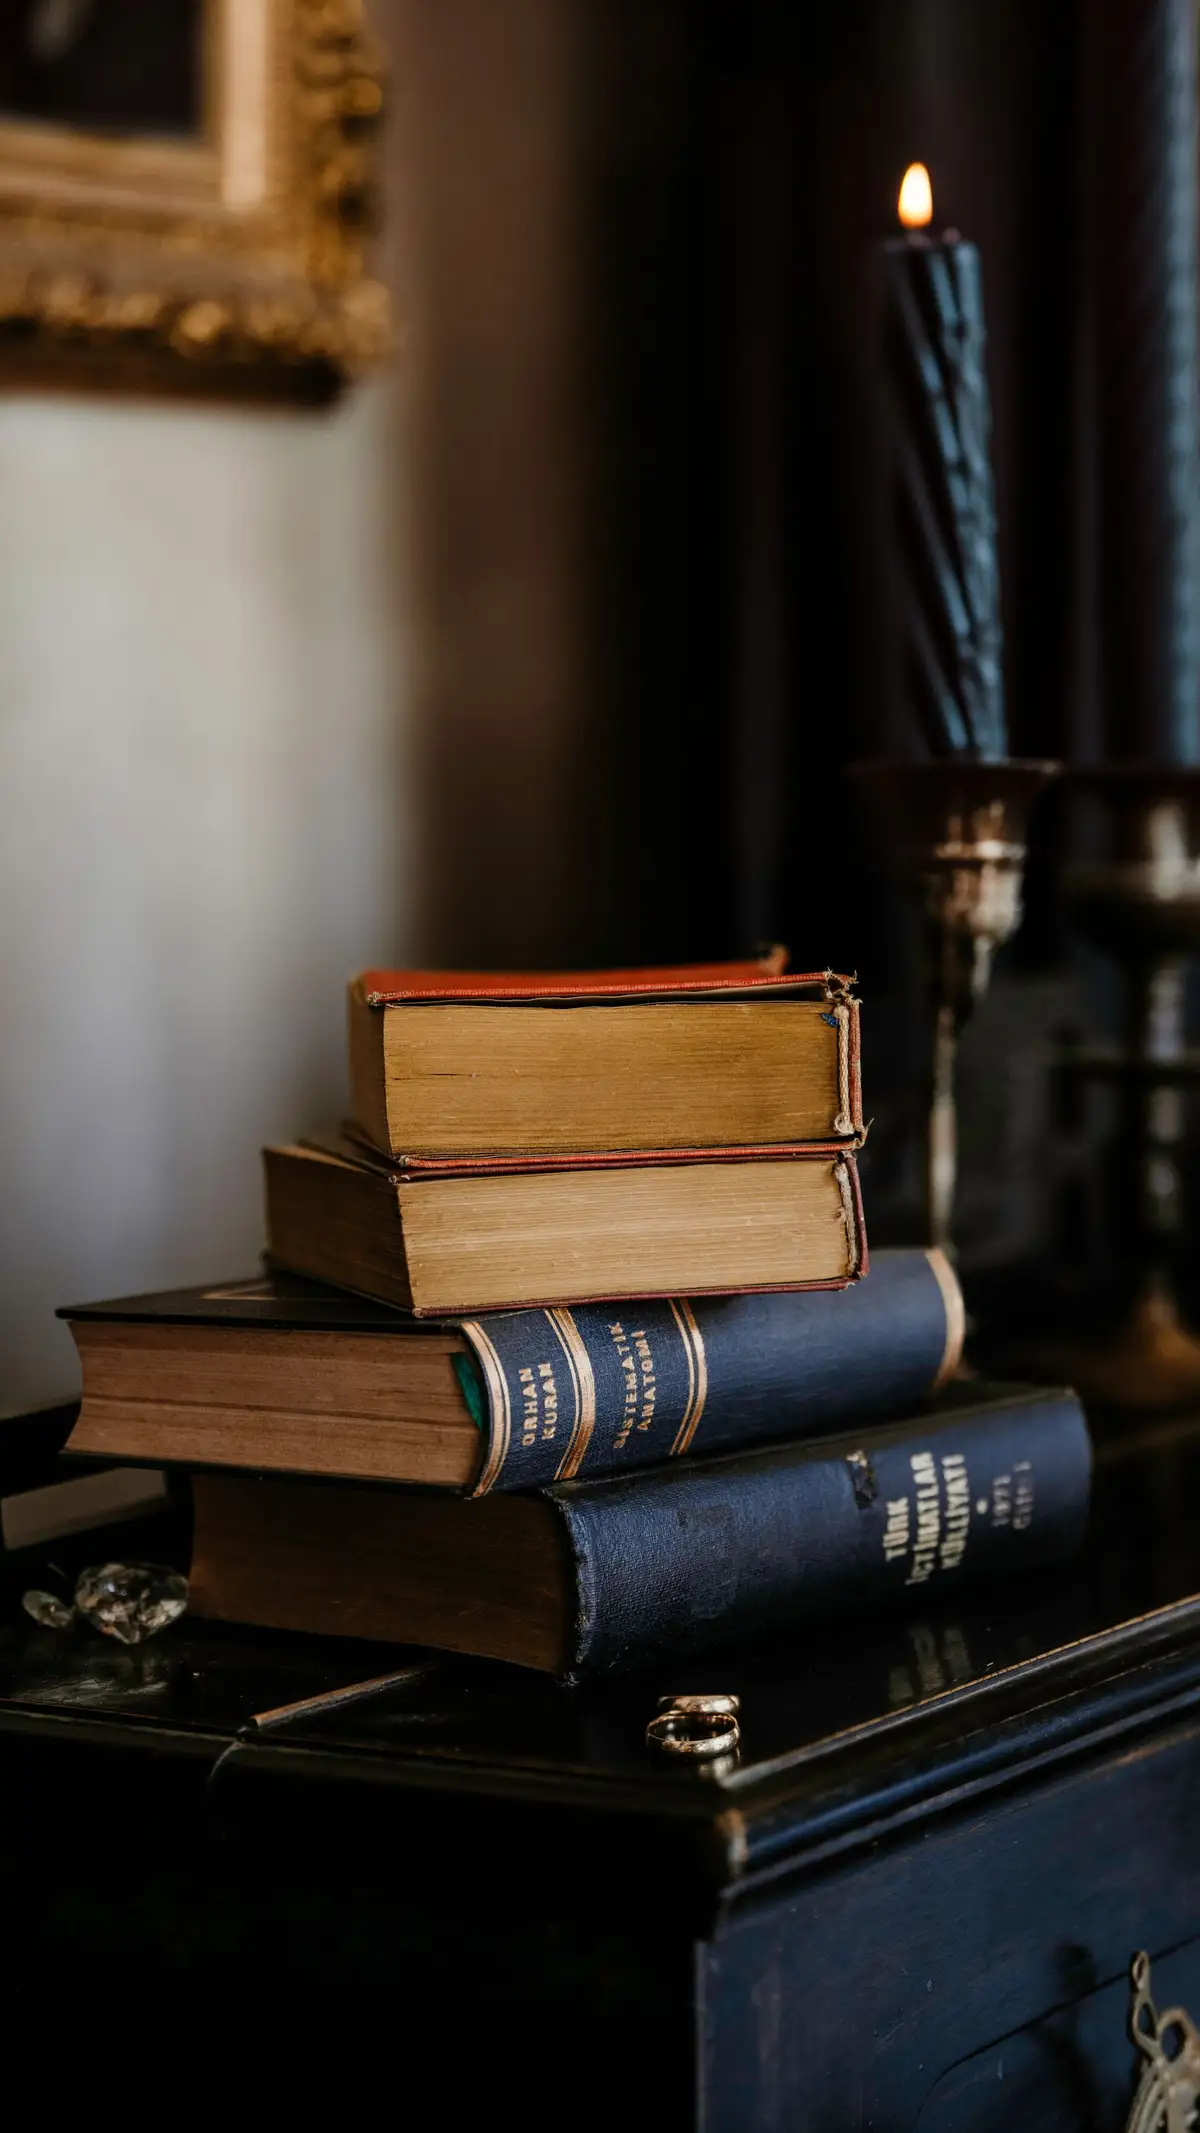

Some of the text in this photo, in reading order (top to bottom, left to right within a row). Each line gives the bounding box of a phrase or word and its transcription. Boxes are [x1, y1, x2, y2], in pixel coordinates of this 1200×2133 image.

[519, 1367, 538, 1447] ORHAN
[538, 1362, 559, 1441] KURAN
[883, 1497, 909, 1562] TÜRK
